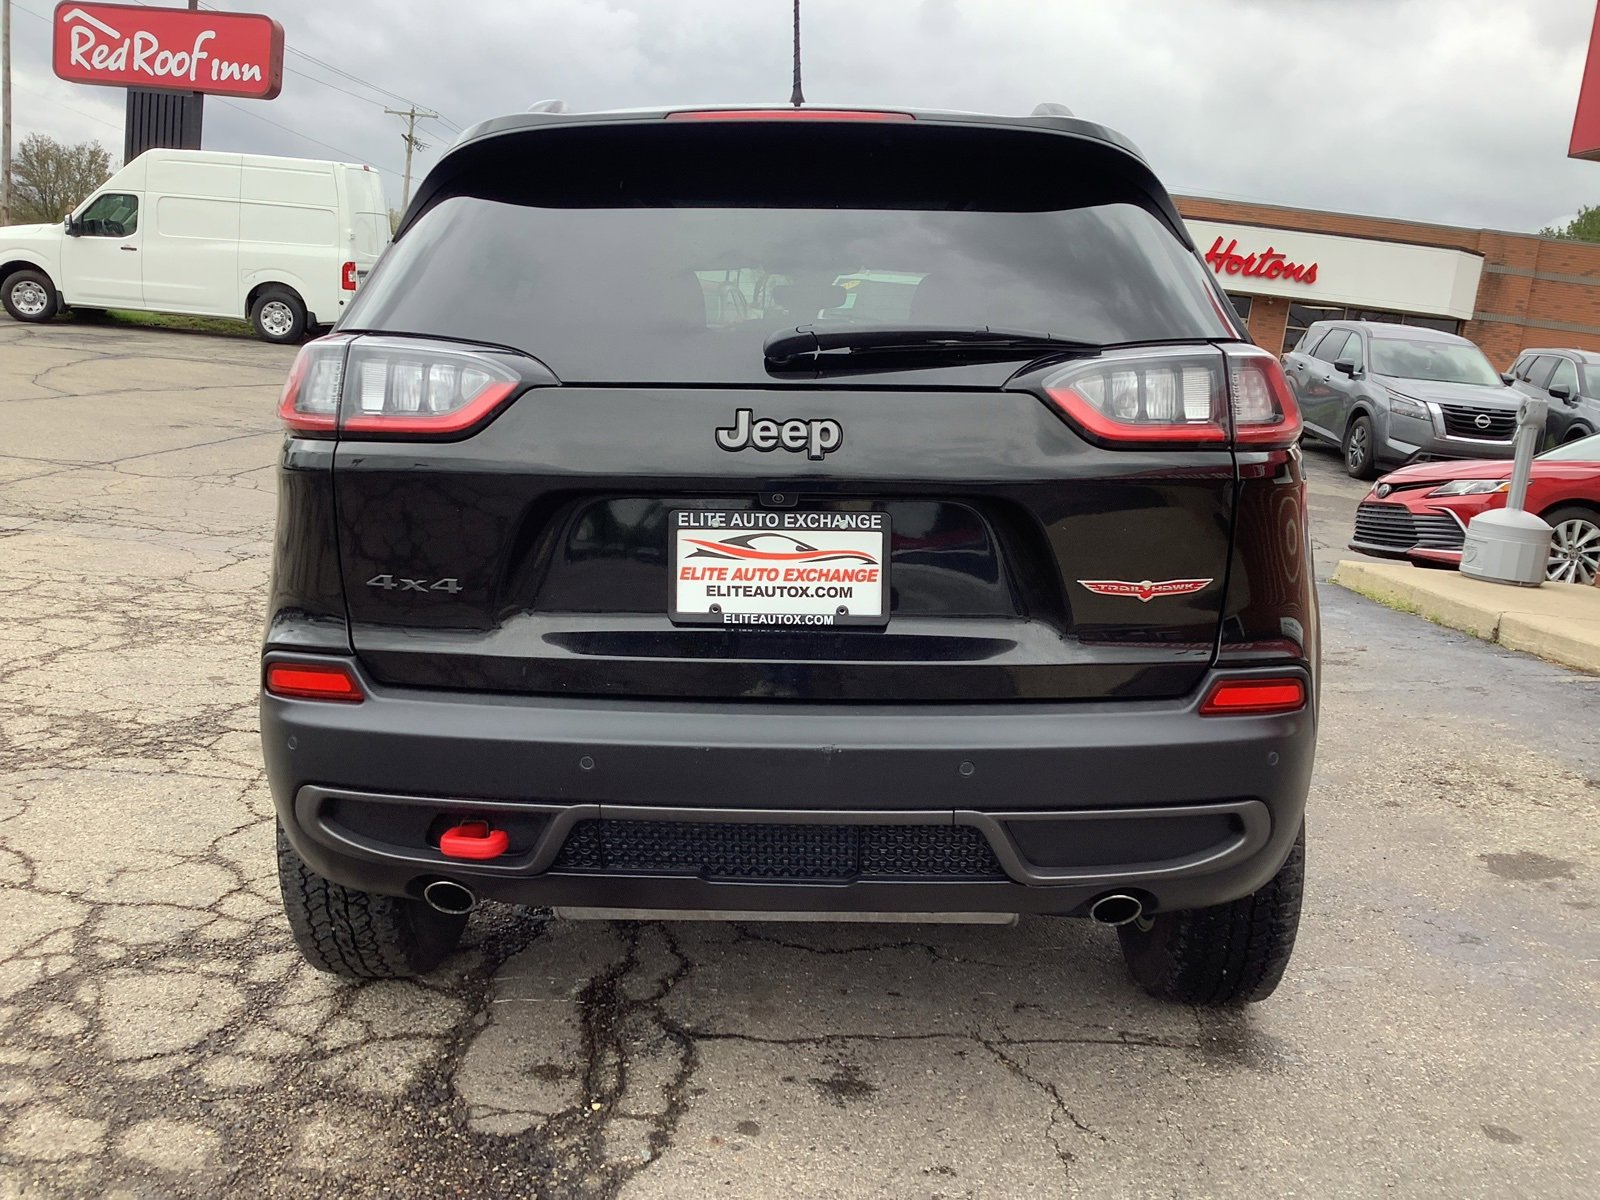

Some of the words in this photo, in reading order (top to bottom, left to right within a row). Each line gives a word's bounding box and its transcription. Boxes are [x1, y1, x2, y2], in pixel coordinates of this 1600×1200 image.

[1205, 235, 1319, 284] Hortons
[715, 408, 843, 460] Jeep
[678, 513, 726, 527] ELITE
[730, 514, 778, 527] AUTO
[784, 514, 882, 529] EXCHANGE
[680, 567, 728, 581] ELITE
[731, 568, 779, 581] AUTO
[783, 568, 879, 583] EXCHANGE
[706, 585, 853, 598] ELITEAUTOX.COM
[724, 614, 833, 625] ELITEAUTOX.COM
